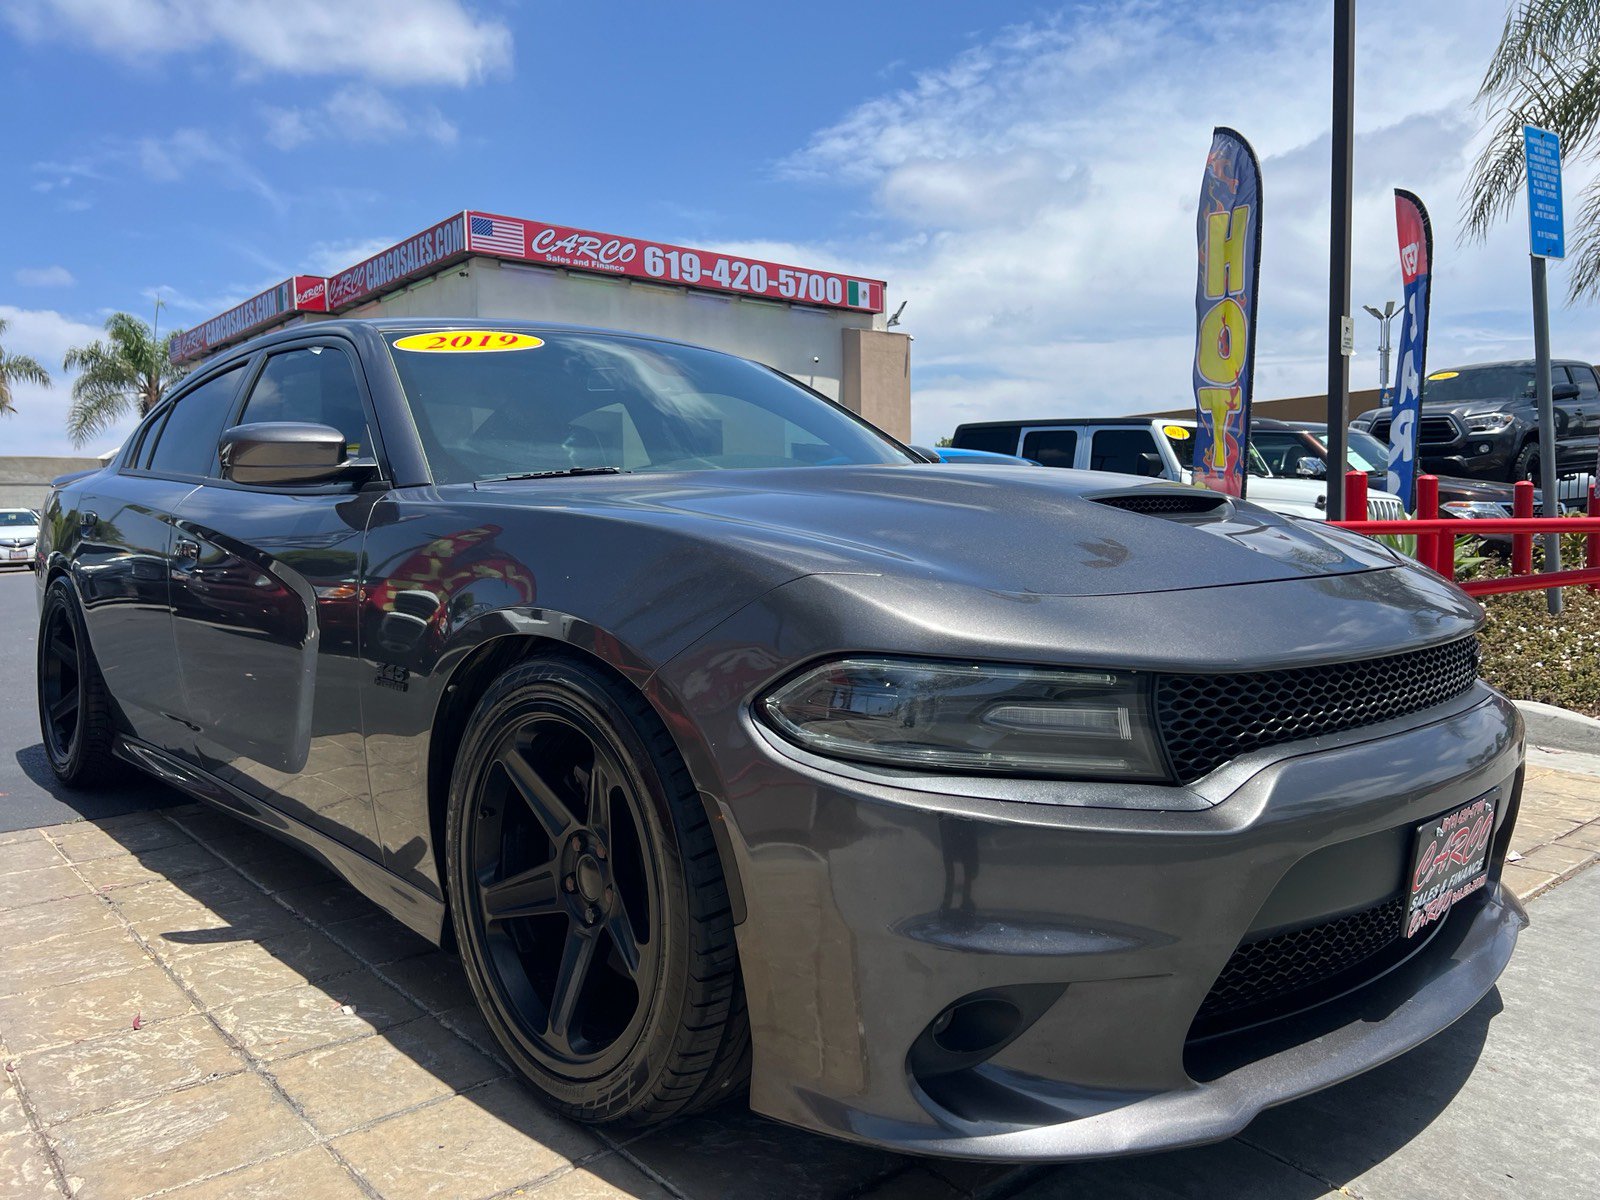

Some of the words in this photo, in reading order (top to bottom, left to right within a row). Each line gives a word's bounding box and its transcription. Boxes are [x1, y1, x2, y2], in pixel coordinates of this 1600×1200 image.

[366, 217, 464, 291] CARCOSALES.COM
[531, 228, 637, 264] CARCO
[546, 253, 571, 265] Sales
[573, 258, 589, 268] and
[592, 260, 625, 273] Finance
[296, 284, 324, 303] CARCO
[644, 246, 842, 304] 619-420-5700
[206, 290, 277, 346] CARCOSALES.COM
[425, 335, 518, 349] 2019
[1197, 203, 1249, 470] HOT
[1412, 811, 1494, 894] CARCO
[1409, 883, 1440, 911] SALES
[1440, 878, 1449, 895] &
[1448, 857, 1484, 888] FINANCE
